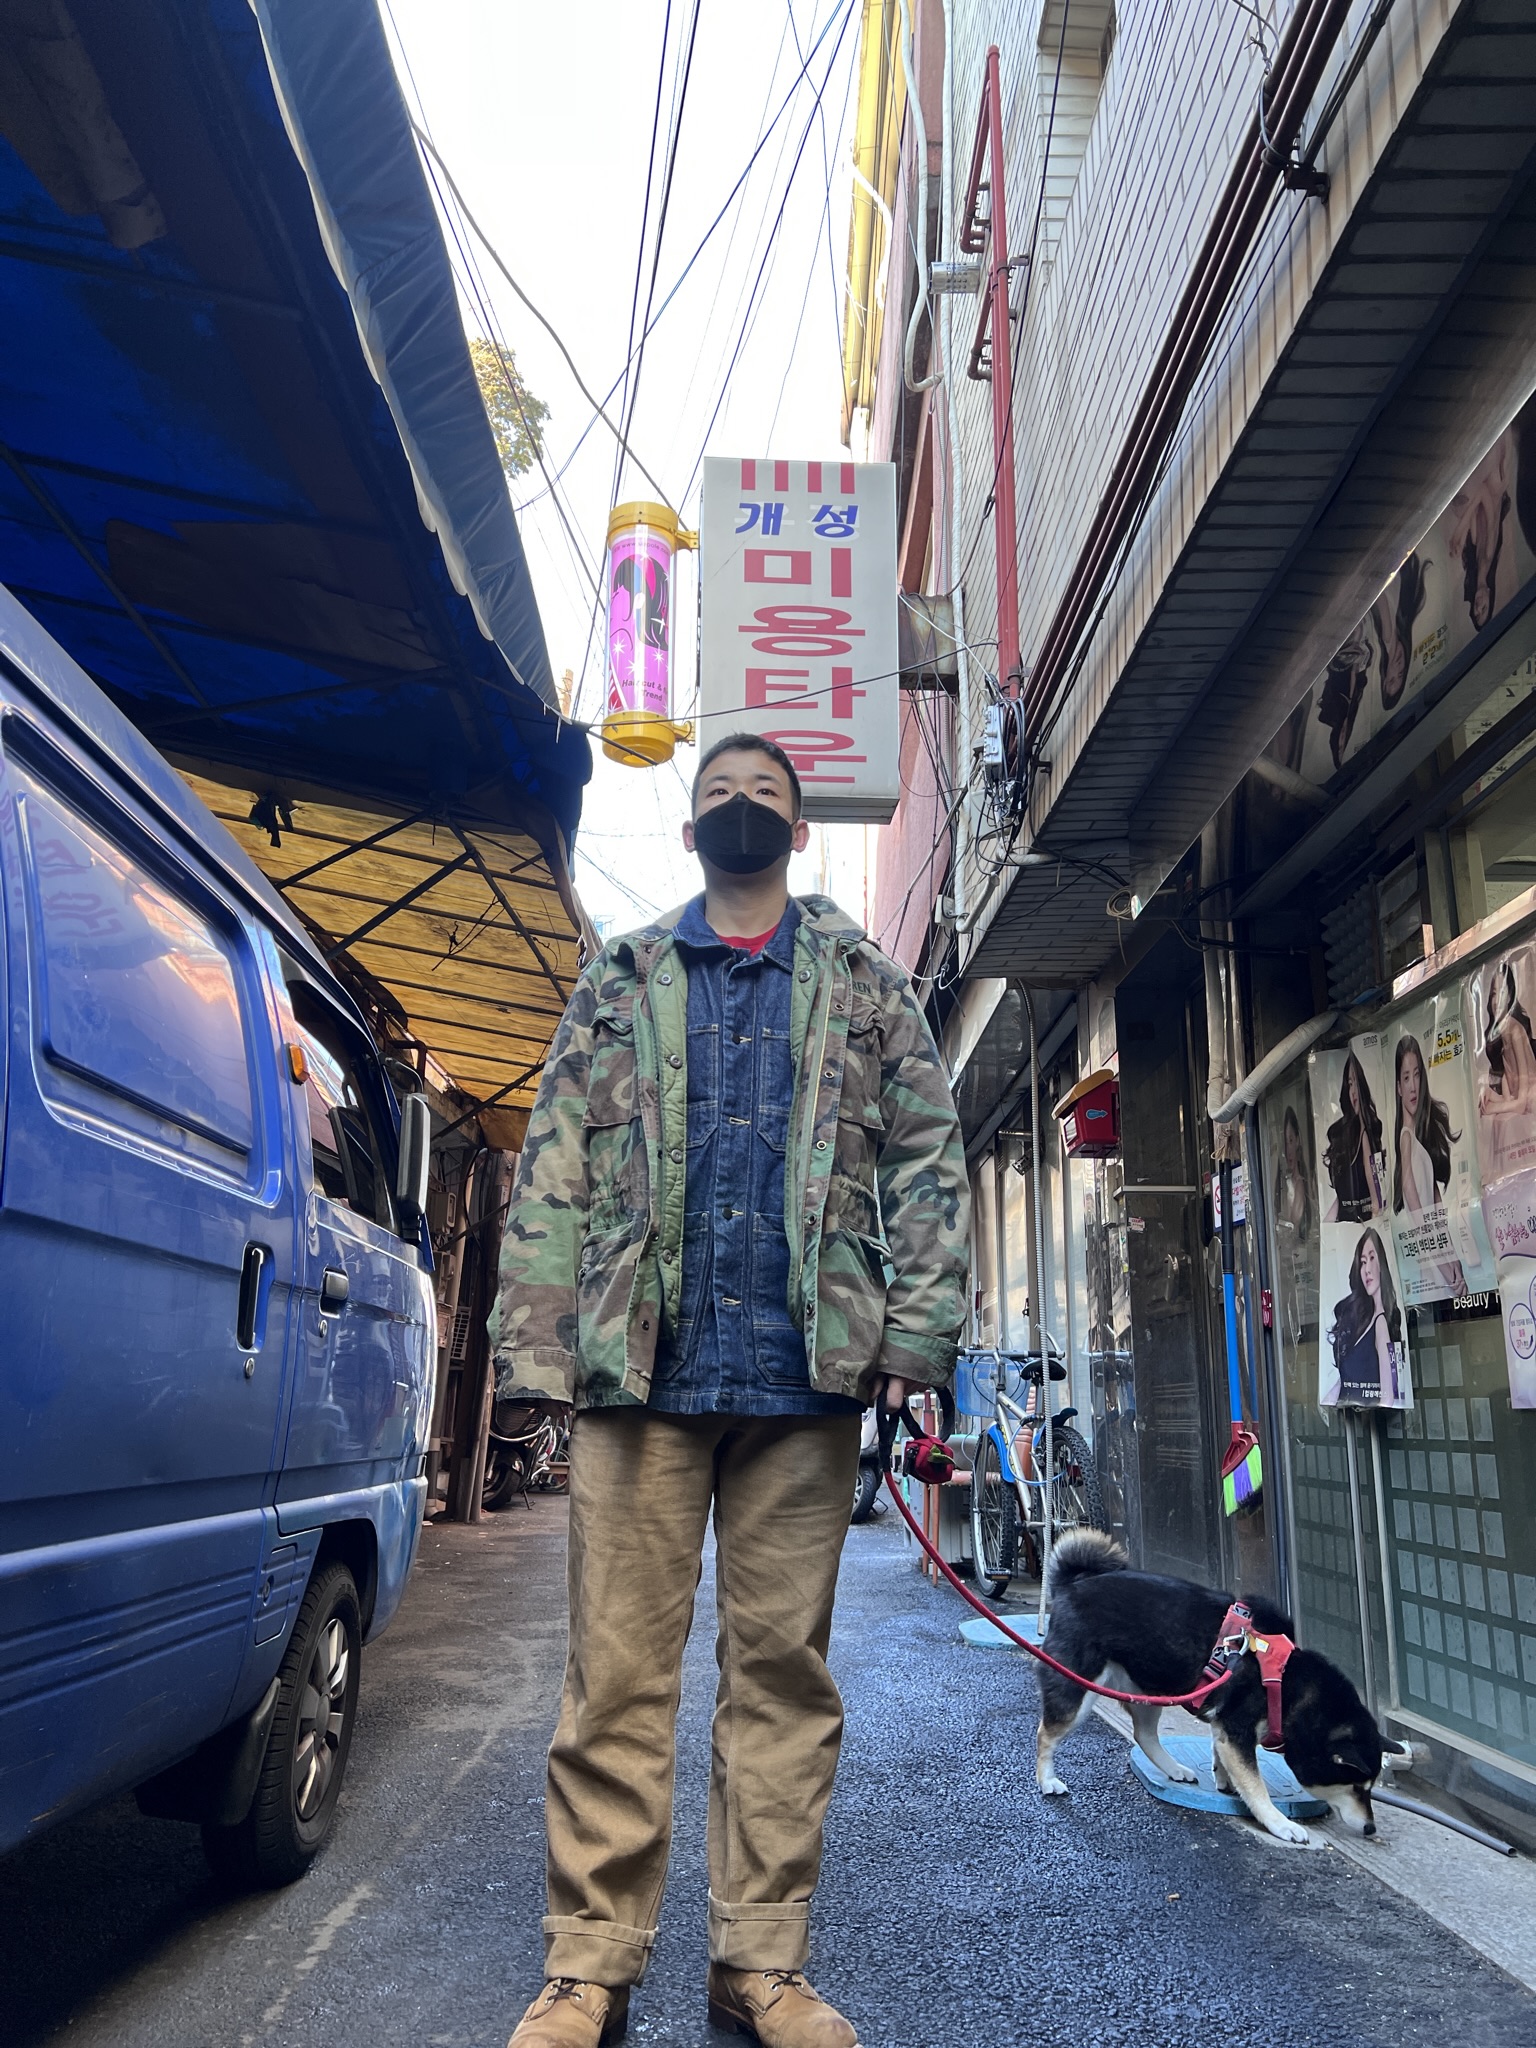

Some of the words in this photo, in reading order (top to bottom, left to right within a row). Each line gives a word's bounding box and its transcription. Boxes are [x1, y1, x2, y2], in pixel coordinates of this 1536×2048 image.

[735, 502, 858, 538] 개성
[642, 689, 663, 702] Trend
[1418, 1236, 1437, 1253] 액티브
[1437, 1232, 1449, 1249] 샴푸
[1453, 1292, 1489, 1310] Beauty
